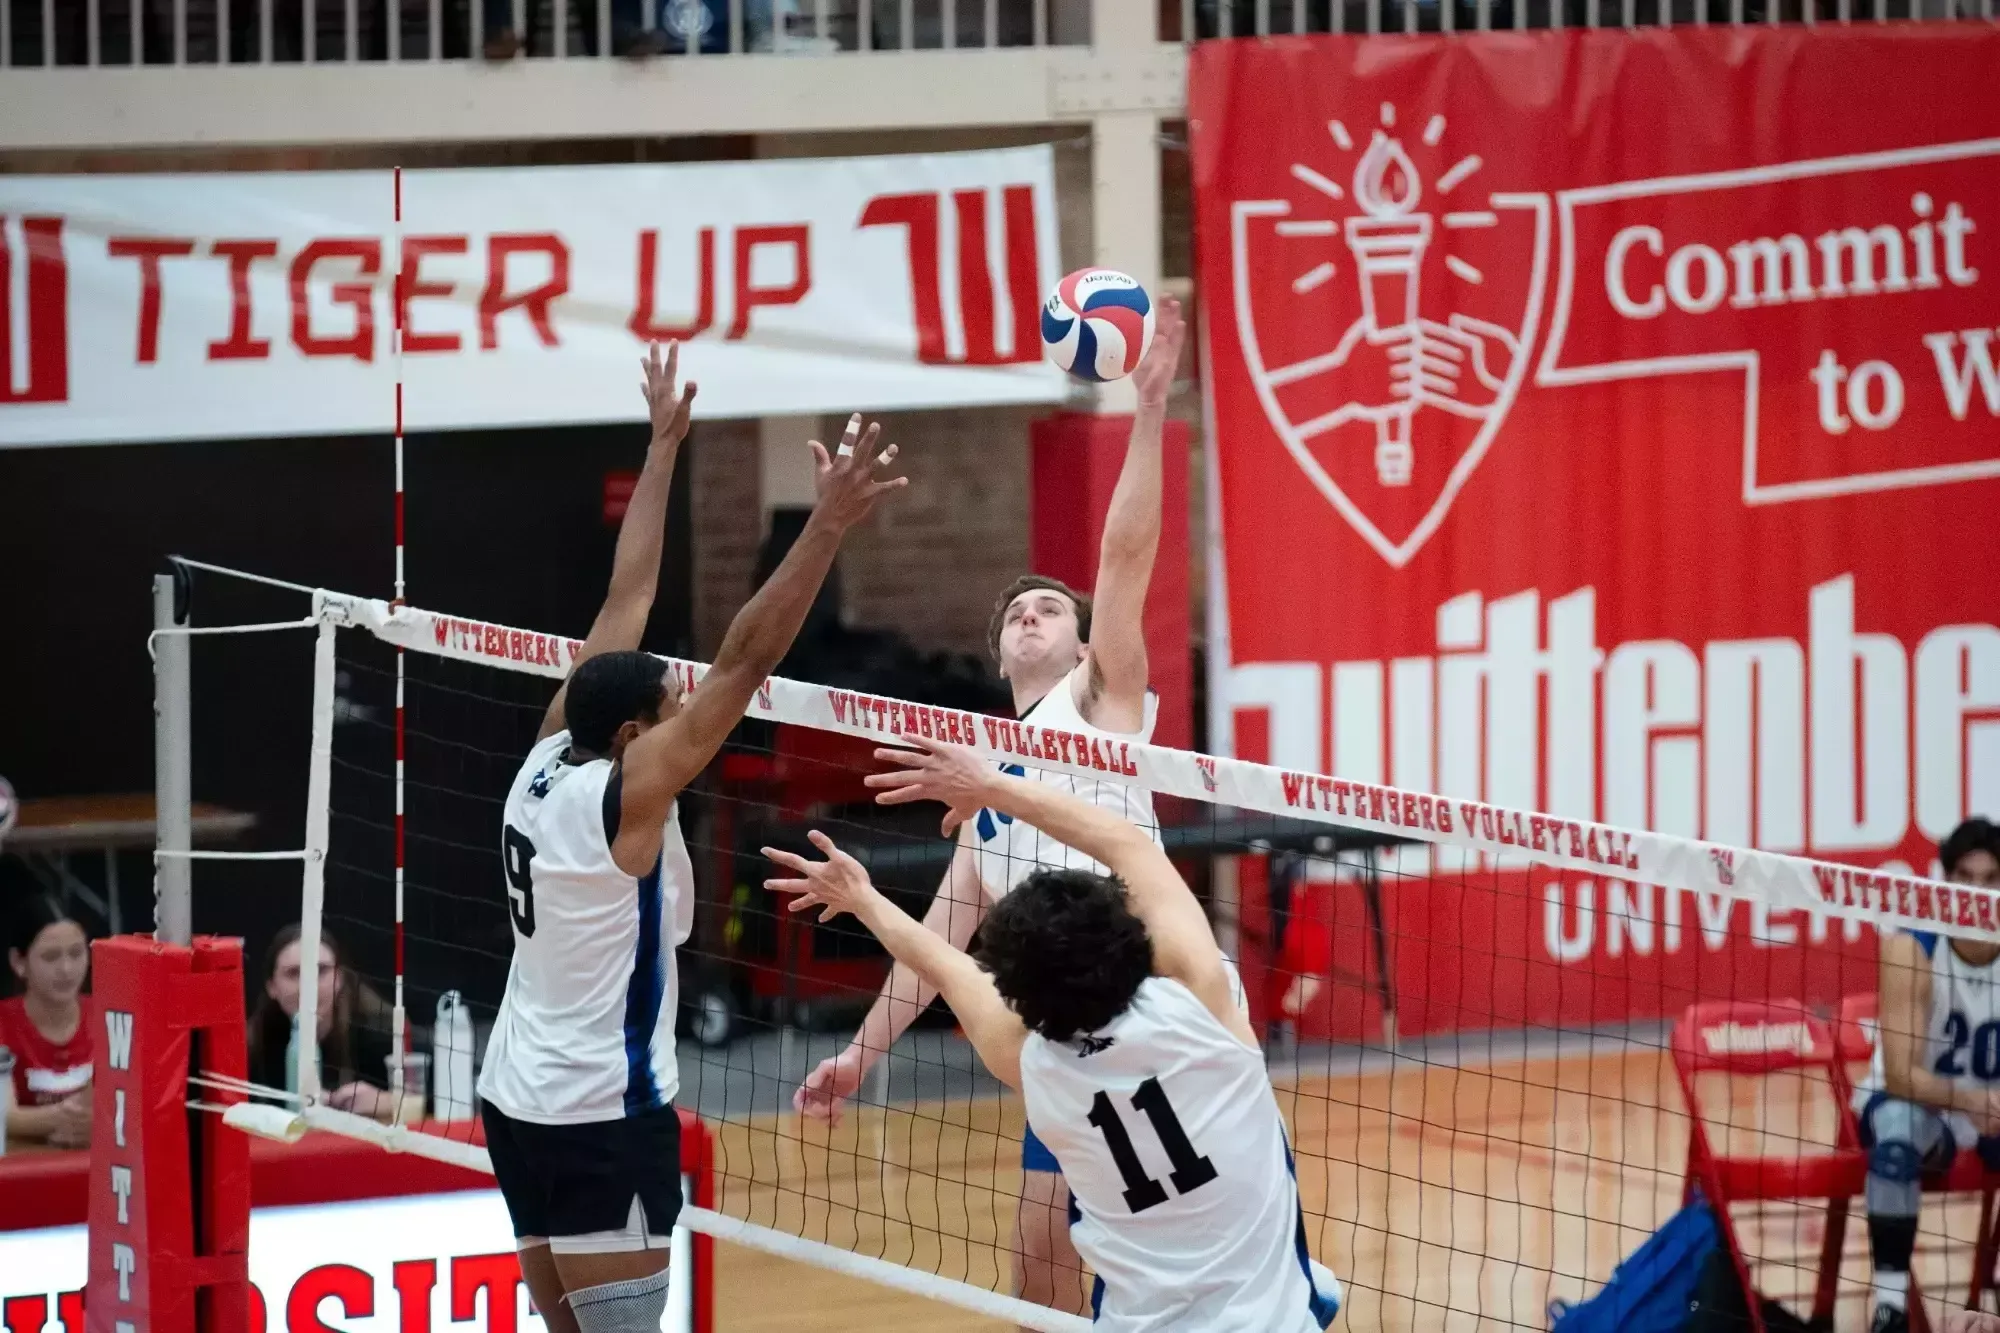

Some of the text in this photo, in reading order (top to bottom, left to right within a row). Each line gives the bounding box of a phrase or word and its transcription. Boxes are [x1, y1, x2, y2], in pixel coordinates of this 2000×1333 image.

[106, 231, 570, 363] TIGER
[629, 221, 812, 341] UP
[1605, 192, 1978, 319] Commit
[1811, 350, 1905, 434] to
[828, 690, 976, 746] WITTENBERG
[982, 715, 1138, 777] VOLLEYBALL
[1280, 771, 1640, 871] WITTENBERG VOLLEYBALL
[503, 823, 538, 939] 9
[1812, 864, 2000, 932] WITTENBER
[1934, 1010, 2000, 1080] 20
[104, 1010, 135, 1333] WITT
[1087, 1075, 1219, 1215] 11
